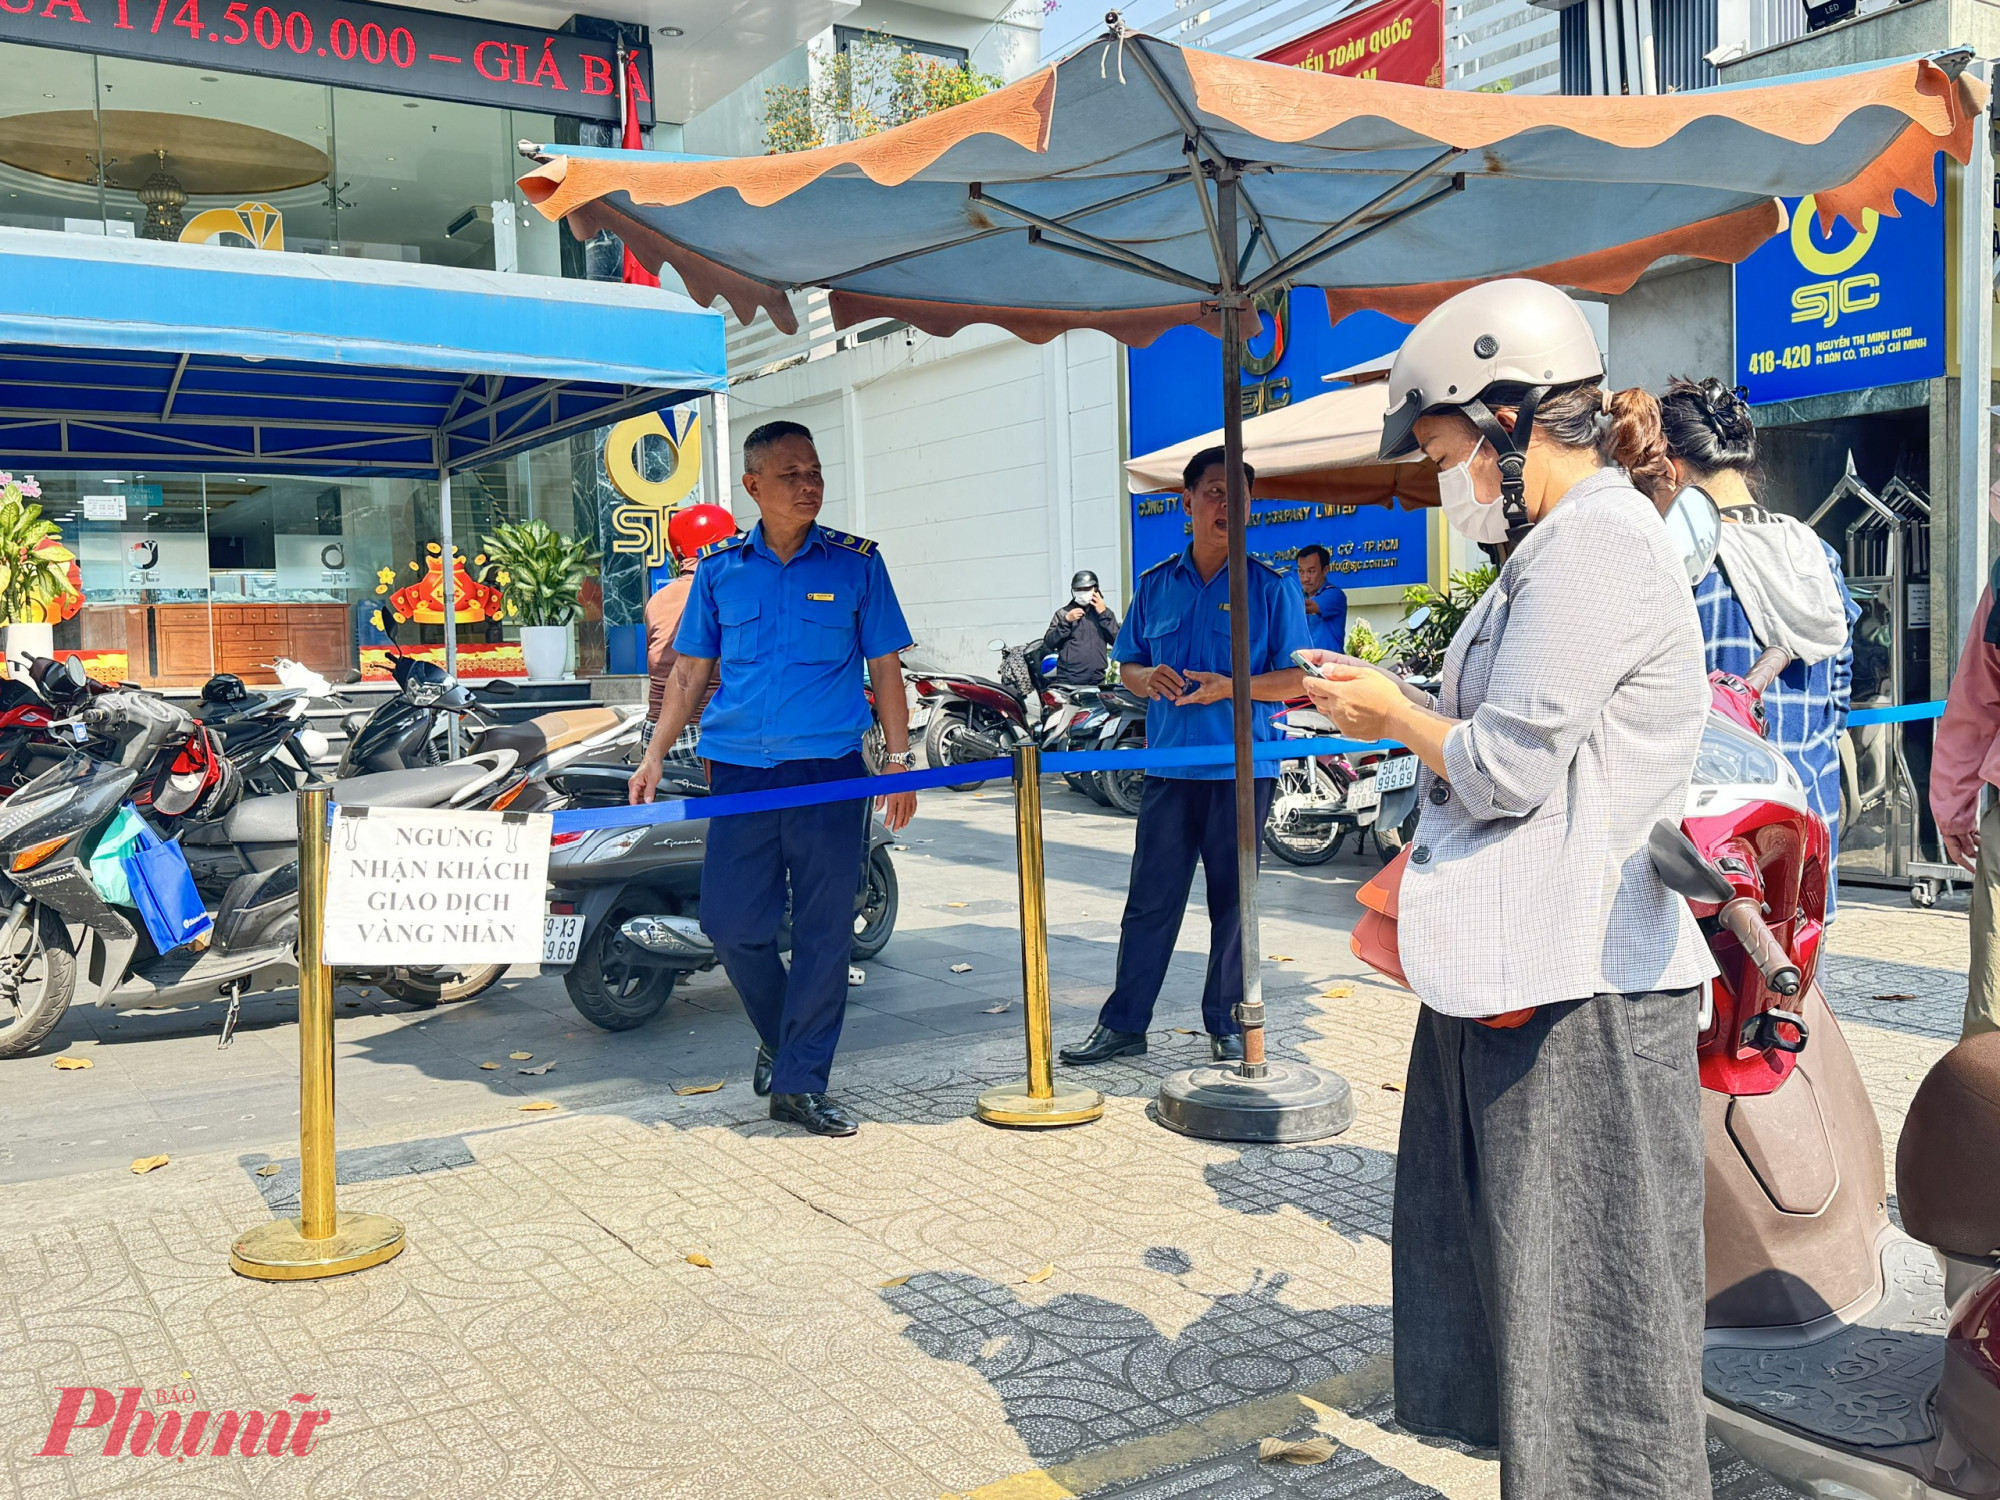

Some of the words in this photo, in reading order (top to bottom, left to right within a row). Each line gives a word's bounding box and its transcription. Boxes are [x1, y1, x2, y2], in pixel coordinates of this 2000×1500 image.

[1824, 3, 1840, 15] LED
[113, 0, 417, 69] 174.500.000
[473, 37, 569, 91] GIÁ
[1327, 37, 1366, 70] TOÀN
[1369, 13, 1413, 54] QUỐC
[1748, 344, 1811, 375] 418-420
[1866, 330, 1890, 344] MINH
[1891, 326, 1912, 339] KHAI
[1903, 337, 1927, 351] MINH
[1166, 497, 1179, 512] TY
[1264, 506, 1311, 526] COMPANY
[1315, 503, 1357, 519] LIMITED
[395, 826, 493, 848] NGƯNG
[32, 872, 76, 888] HONDA
[350, 857, 428, 884] NHẬN
[436, 856, 530, 881] KHÁCH
[367, 891, 438, 911] GIAO
[446, 893, 510, 917] DỊCH
[357, 918, 434, 943] VÀNG
[544, 918, 576, 938] 9-X3
[544, 940, 576, 961] 9.68
